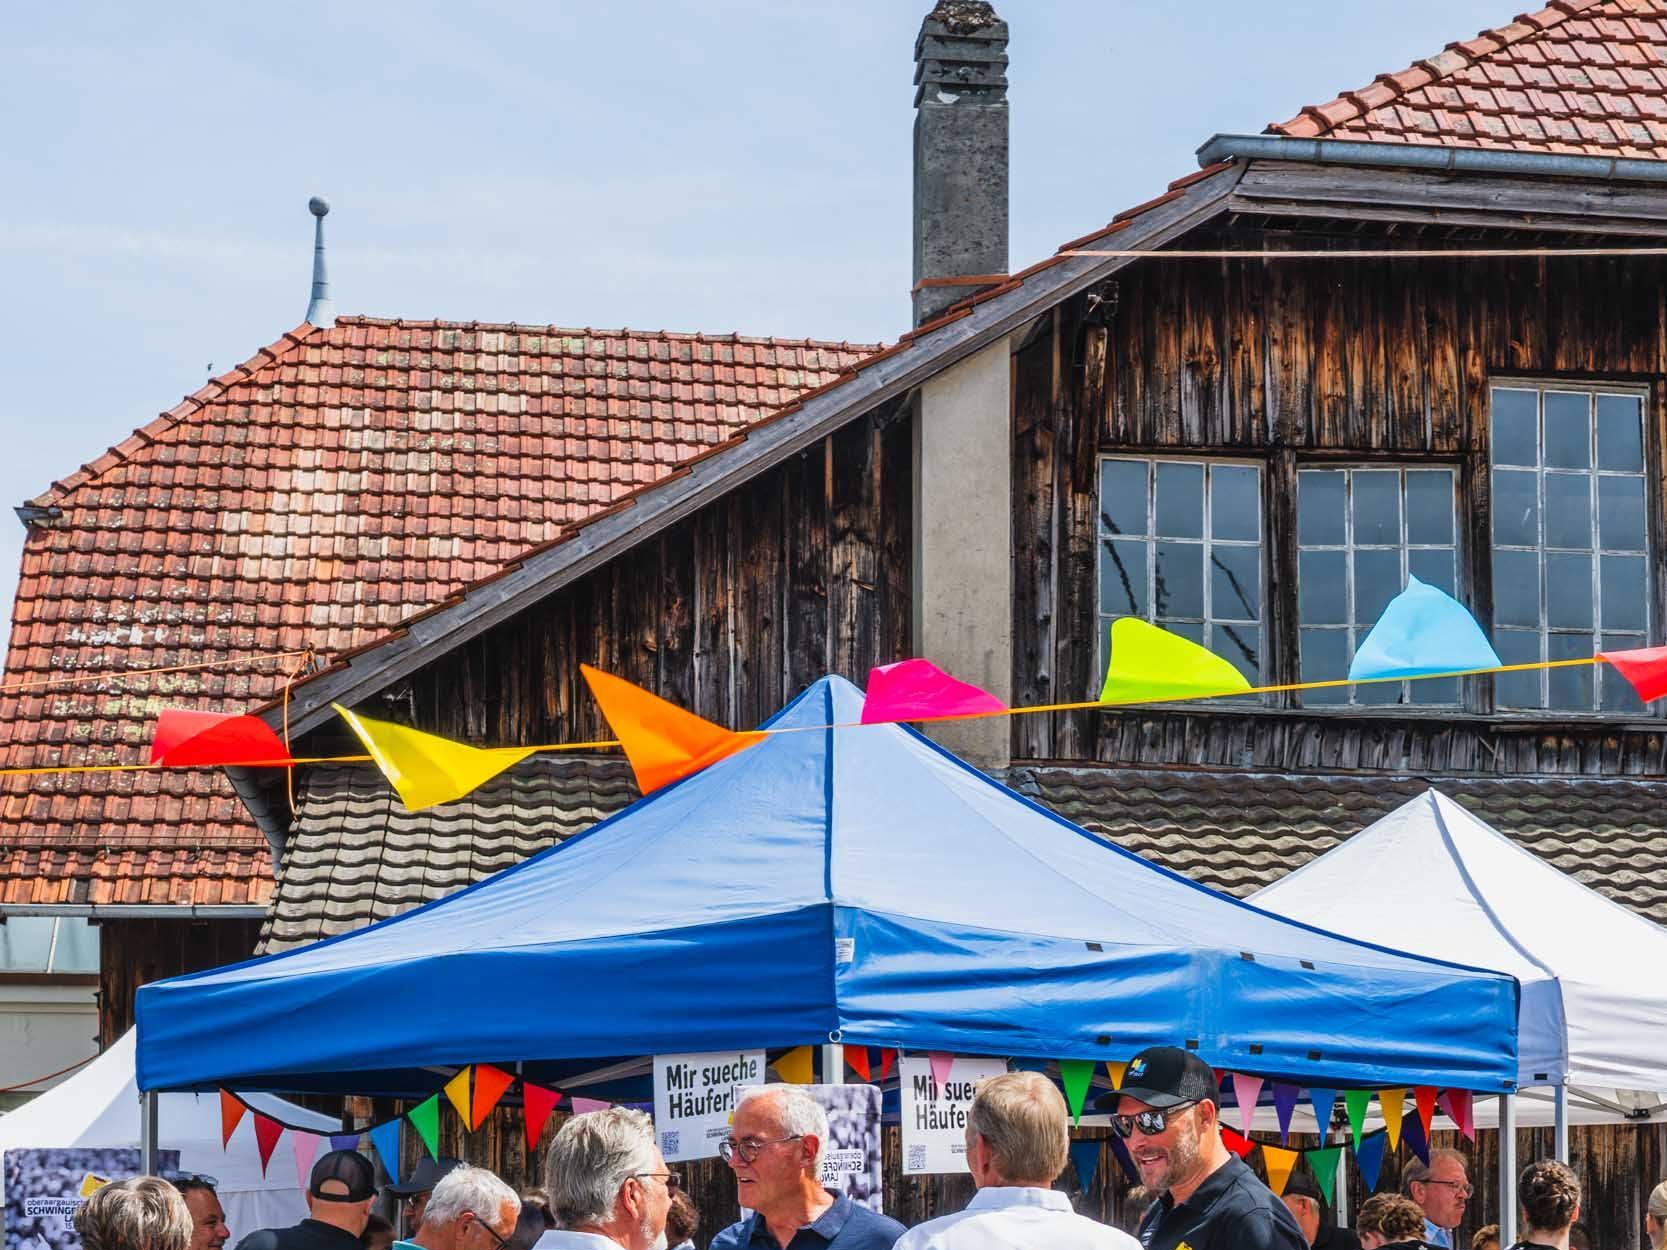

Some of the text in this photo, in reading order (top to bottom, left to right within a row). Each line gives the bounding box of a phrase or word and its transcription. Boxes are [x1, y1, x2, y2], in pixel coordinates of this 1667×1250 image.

[666, 1054, 757, 1091] Mir sueche
[669, 1085, 734, 1119] Häufer!
